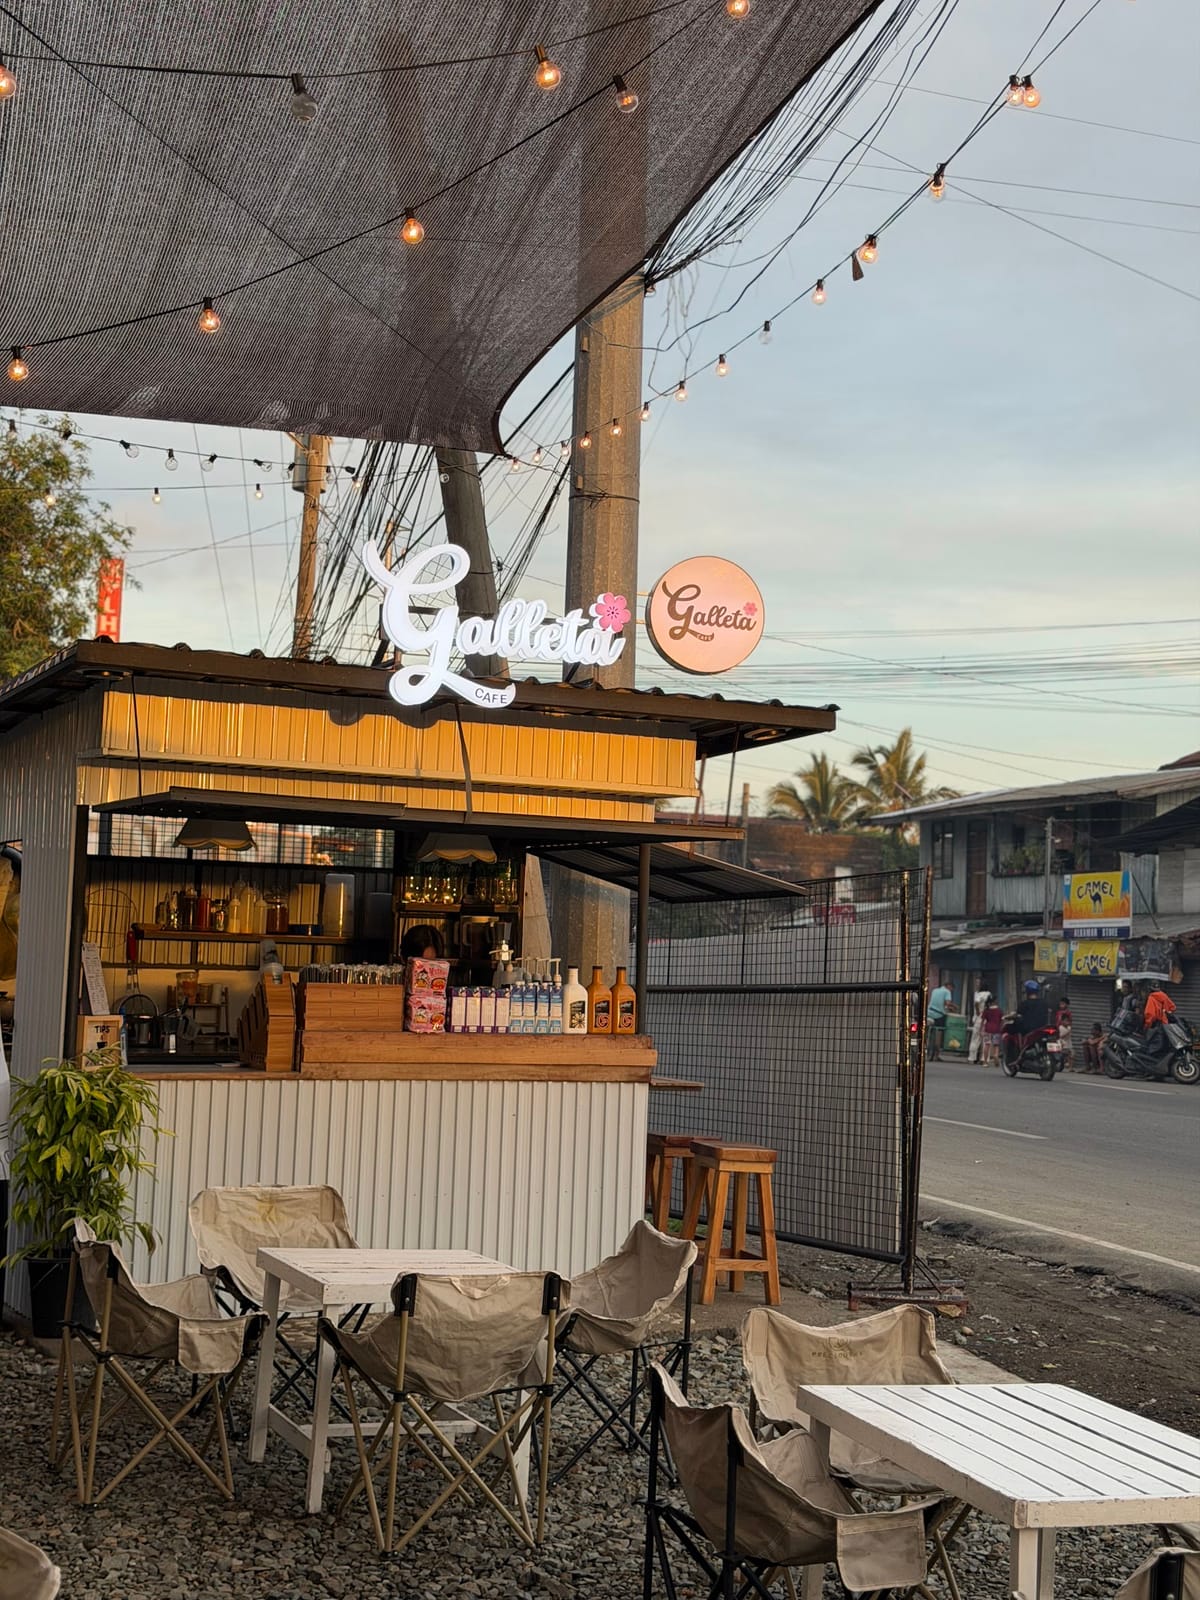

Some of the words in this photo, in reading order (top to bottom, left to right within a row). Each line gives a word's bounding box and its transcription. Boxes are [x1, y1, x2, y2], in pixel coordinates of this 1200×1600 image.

[661, 581, 757, 642] Galleta
[362, 539, 627, 708] Galleta
[474, 687, 508, 705] CAFE
[1076, 880, 1115, 900] CAMEL
[1075, 954, 1112, 972] CAMEL
[94, 1025, 111, 1034] TIPS
